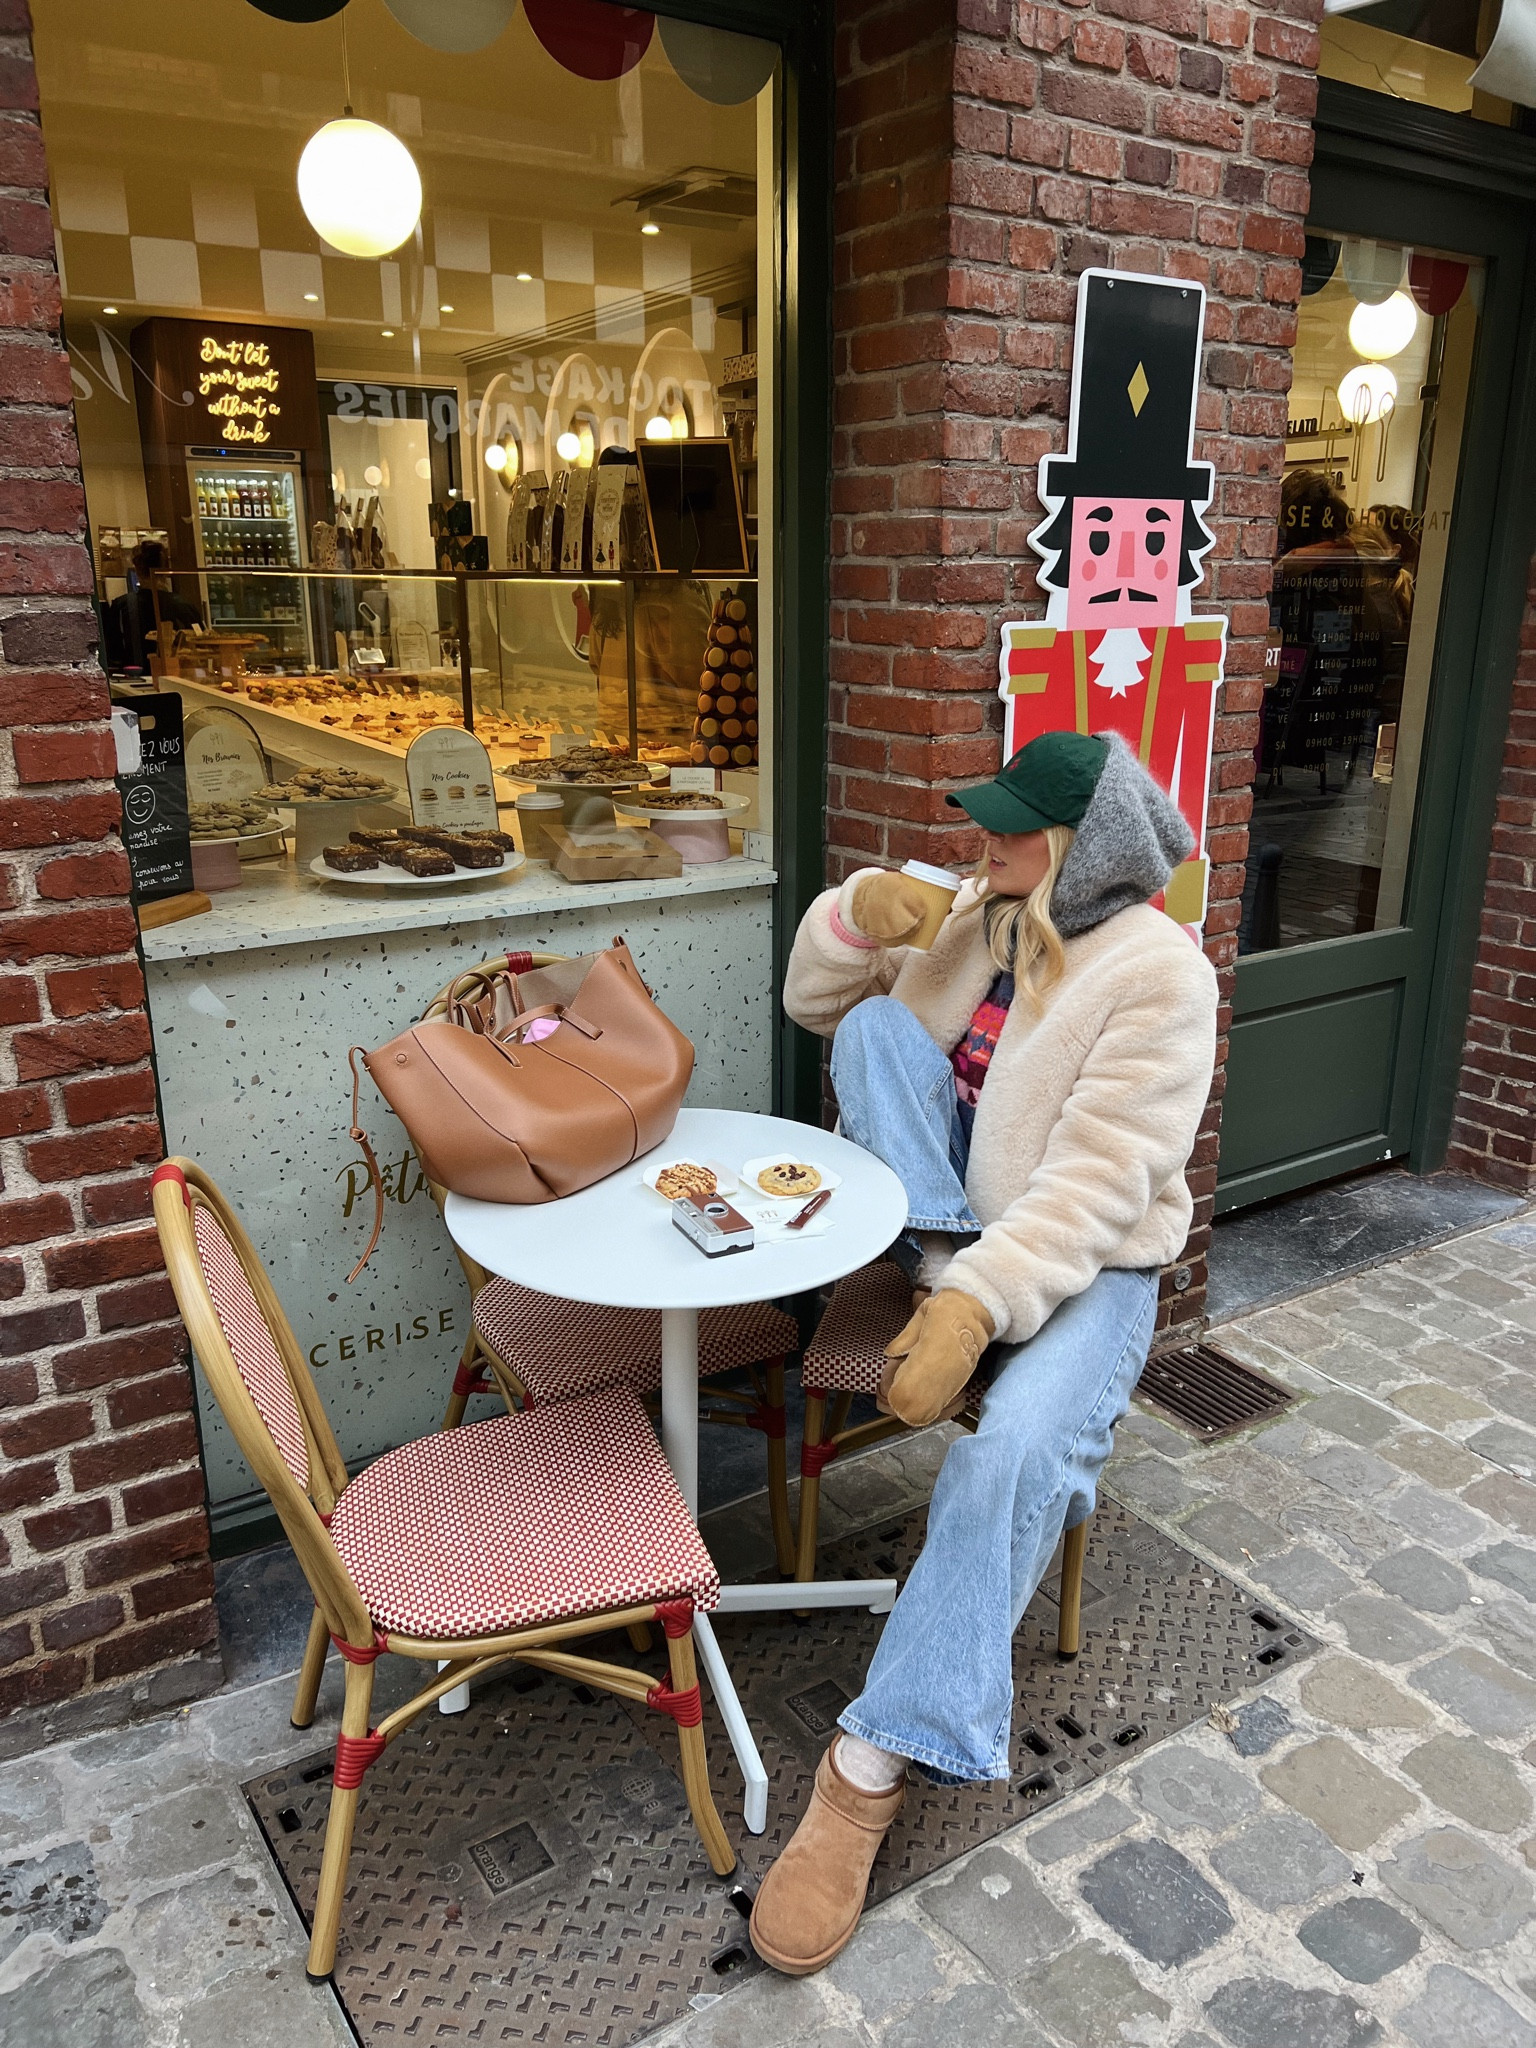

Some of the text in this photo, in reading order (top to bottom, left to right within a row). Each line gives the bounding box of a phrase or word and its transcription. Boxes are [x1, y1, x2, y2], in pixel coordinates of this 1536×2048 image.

[244, 342, 269, 367] let
[199, 369, 279, 395] your sweet
[207, 393, 281, 419] without a
[222, 419, 271, 443] drink
[1321, 506, 1335, 529] &
[1345, 507, 1451, 532] CHOCOLAT
[1283, 577, 1329, 589] HORAIRES
[1288, 606, 1300, 616] LU
[1286, 634, 1298, 643] MA
[1354, 632, 1380, 642] 19H00
[1351, 658, 1377, 668] 19H00
[1348, 684, 1374, 694] 19H00
[1346, 710, 1372, 720] 19H00
[159, 736, 180, 755] VOUS
[1275, 740, 1286, 751] SA
[1305, 737, 1333, 748] 09H00
[431, 771, 470, 782] Nos Cookies
[150, 822, 173, 835] votre
[309, 1307, 456, 1368] CERISE
[791, 1696, 824, 1730] orange
[475, 1844, 505, 1885] orange
